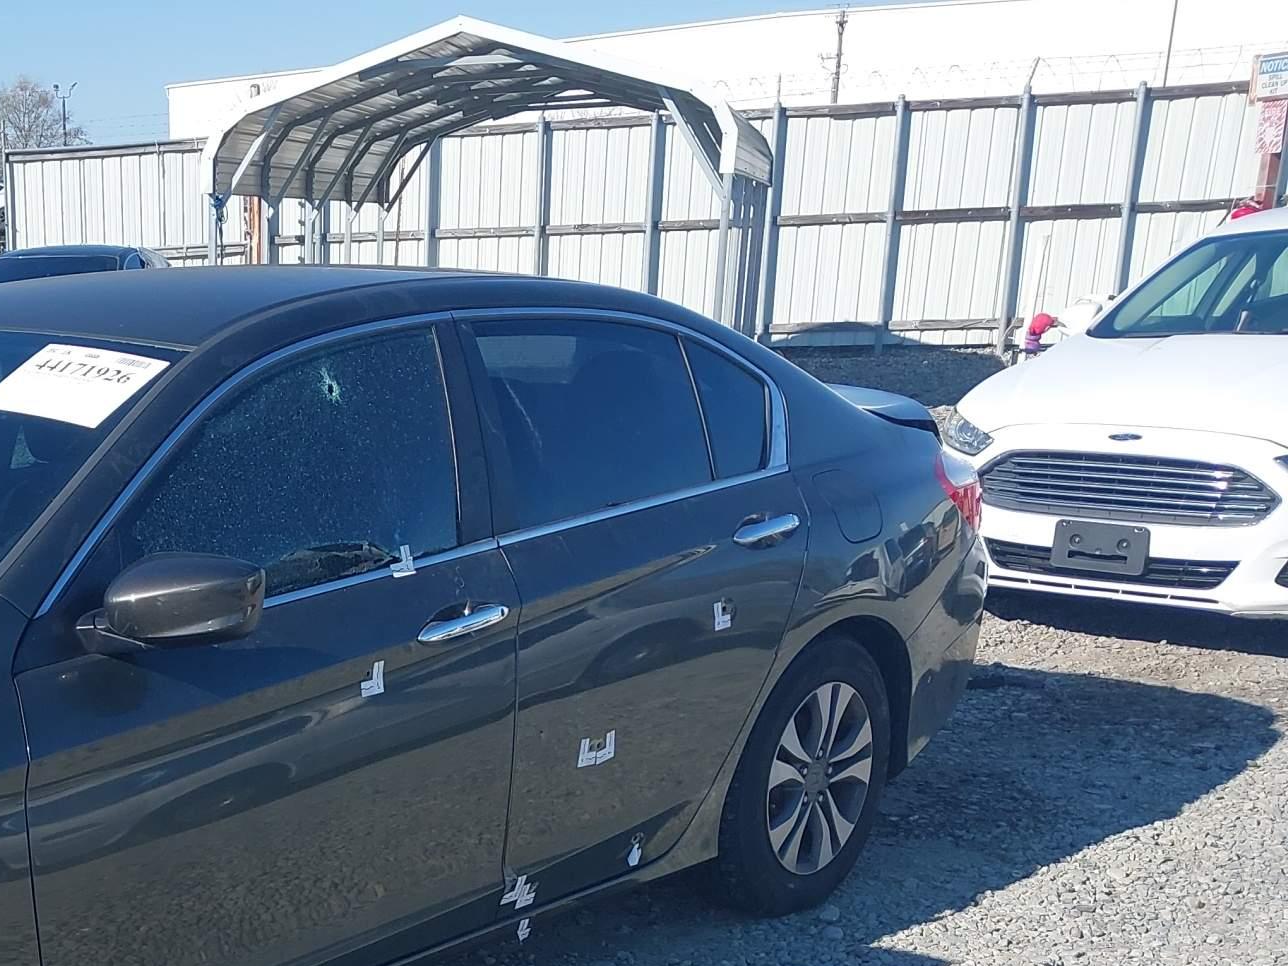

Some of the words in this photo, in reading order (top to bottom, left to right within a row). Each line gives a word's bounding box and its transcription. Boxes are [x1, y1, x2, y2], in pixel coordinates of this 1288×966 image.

[1261, 59, 1288, 73] NOTIC
[1262, 80, 1279, 89] CLEAN
[35, 358, 137, 384] 44171926
